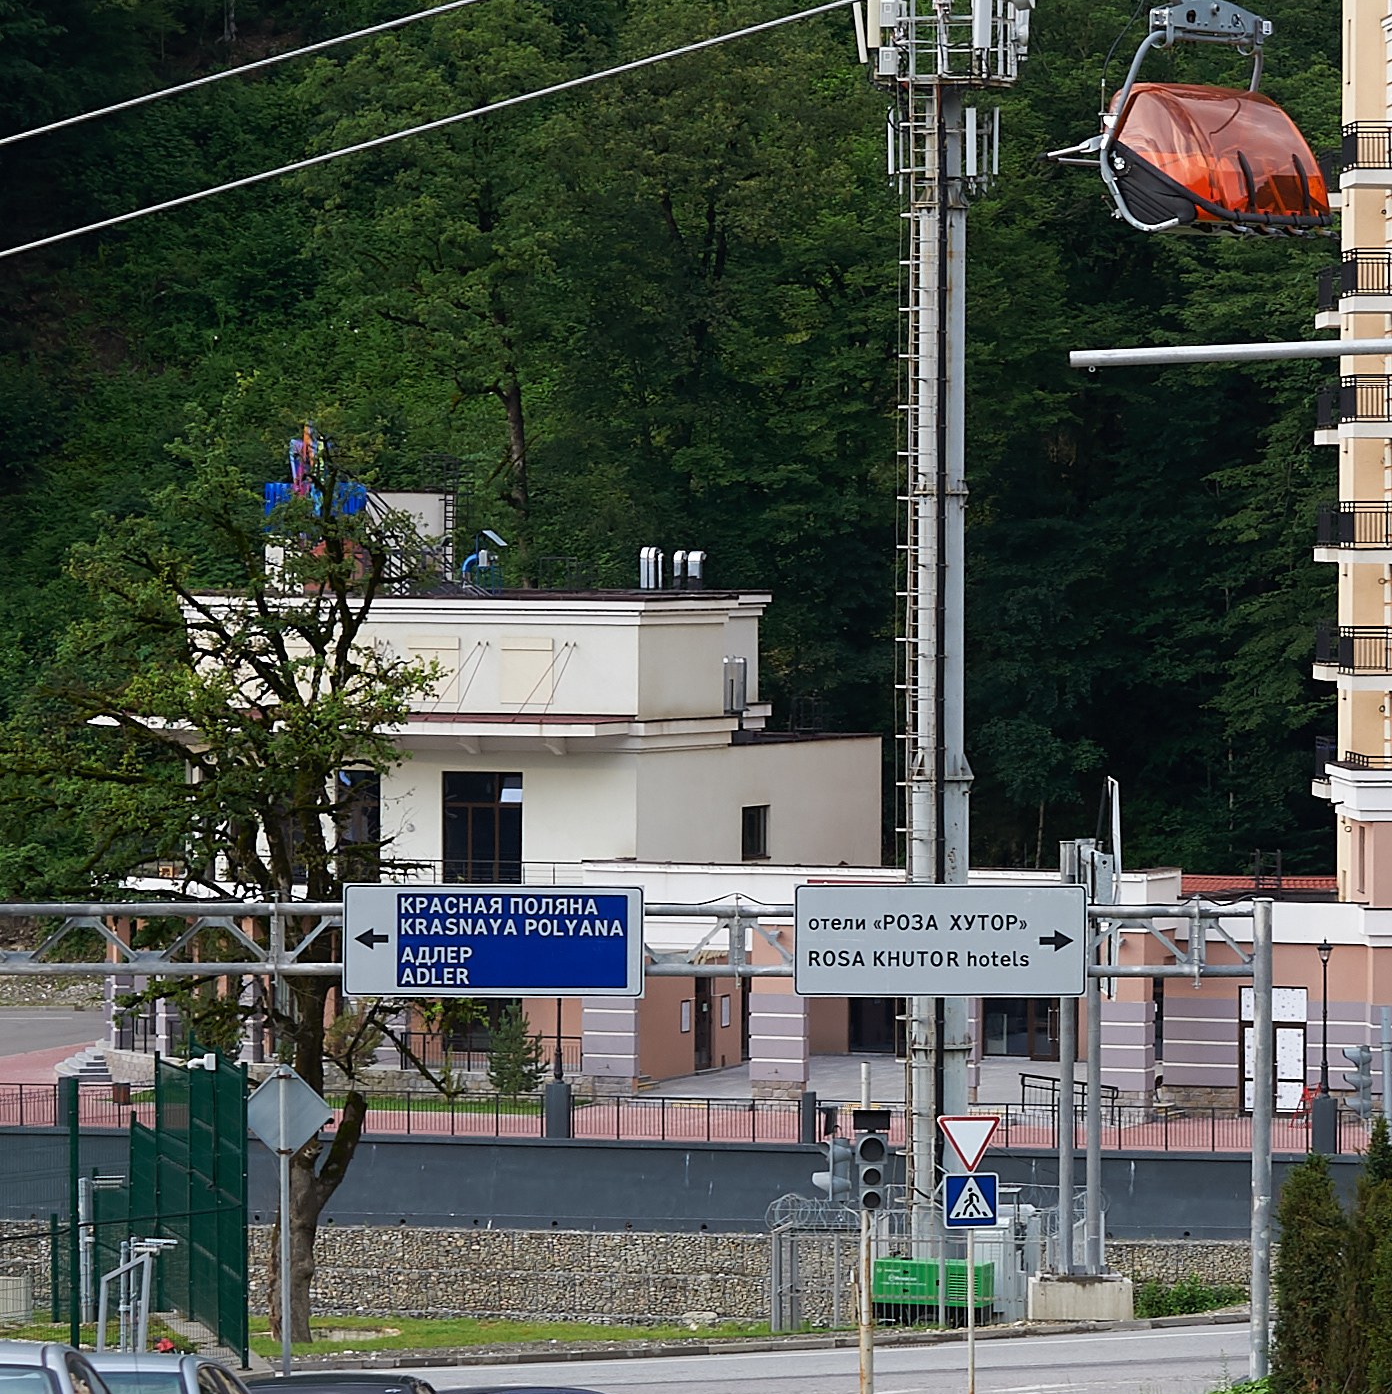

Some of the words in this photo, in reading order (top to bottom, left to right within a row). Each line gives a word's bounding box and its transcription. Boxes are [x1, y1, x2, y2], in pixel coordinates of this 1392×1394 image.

[401, 897, 503, 915] КРАСНАЯ
[510, 897, 599, 916] ПОЛЯНА
[401, 918, 518, 936] KRASNAYA
[524, 918, 624, 937] POLYANA
[808, 917, 866, 931] отели
[873, 913, 939, 931] «РОЗА
[949, 913, 1028, 931] ХУТОР»
[401, 946, 473, 966] АДЛЕР
[808, 950, 866, 968] ROSA
[873, 950, 960, 968] KHUTOR
[967, 950, 1030, 968] hotels
[401, 967, 470, 985] ADLER
